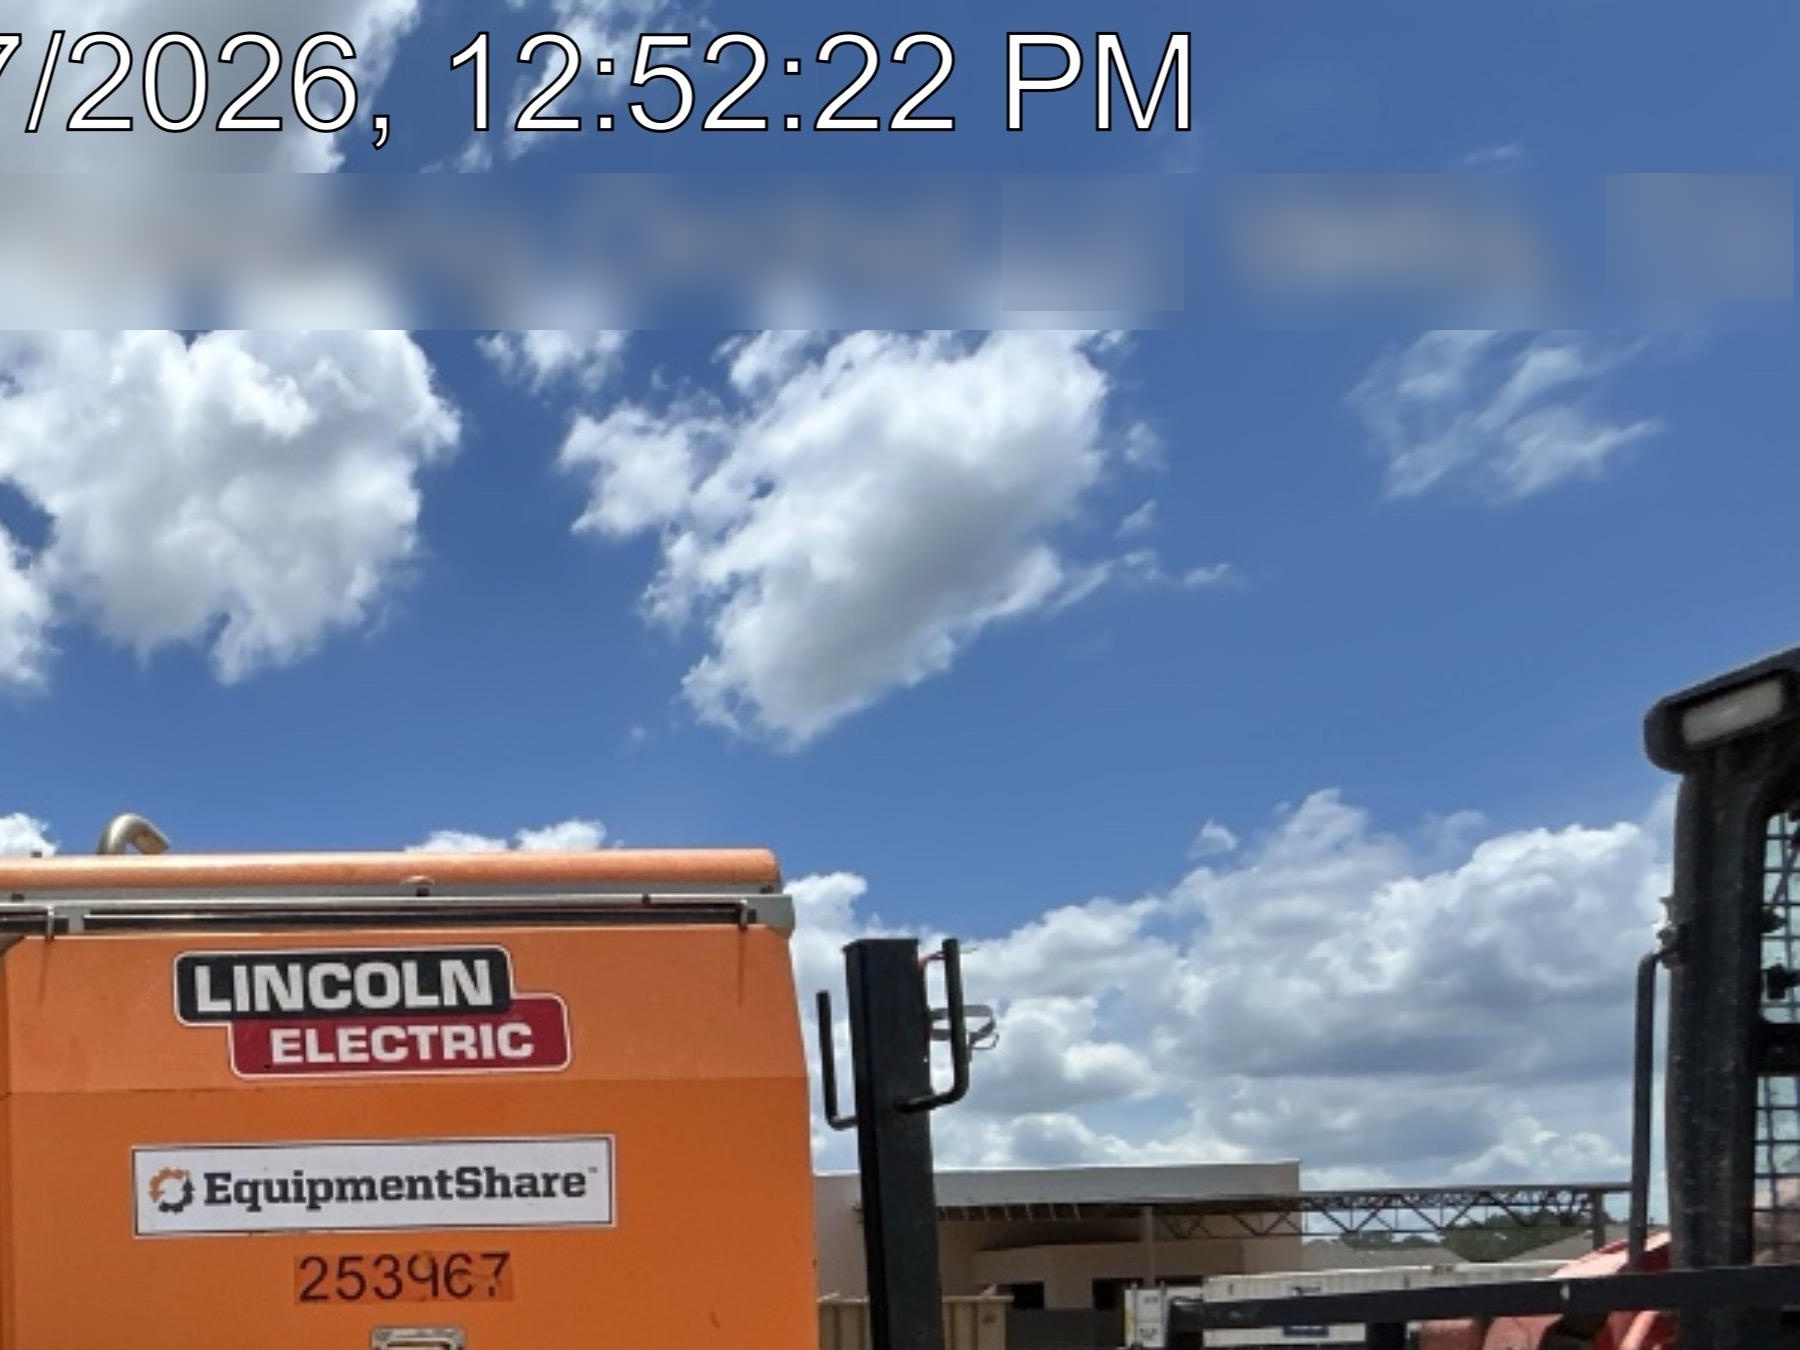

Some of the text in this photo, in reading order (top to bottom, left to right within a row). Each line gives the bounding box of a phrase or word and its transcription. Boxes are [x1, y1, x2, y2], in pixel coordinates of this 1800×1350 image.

[194, 958, 494, 1013] LINCOLN
[269, 1021, 535, 1064] ELECTRIC
[203, 1166, 588, 1213] EquipmentShare
[298, 1250, 511, 1301] 253967
